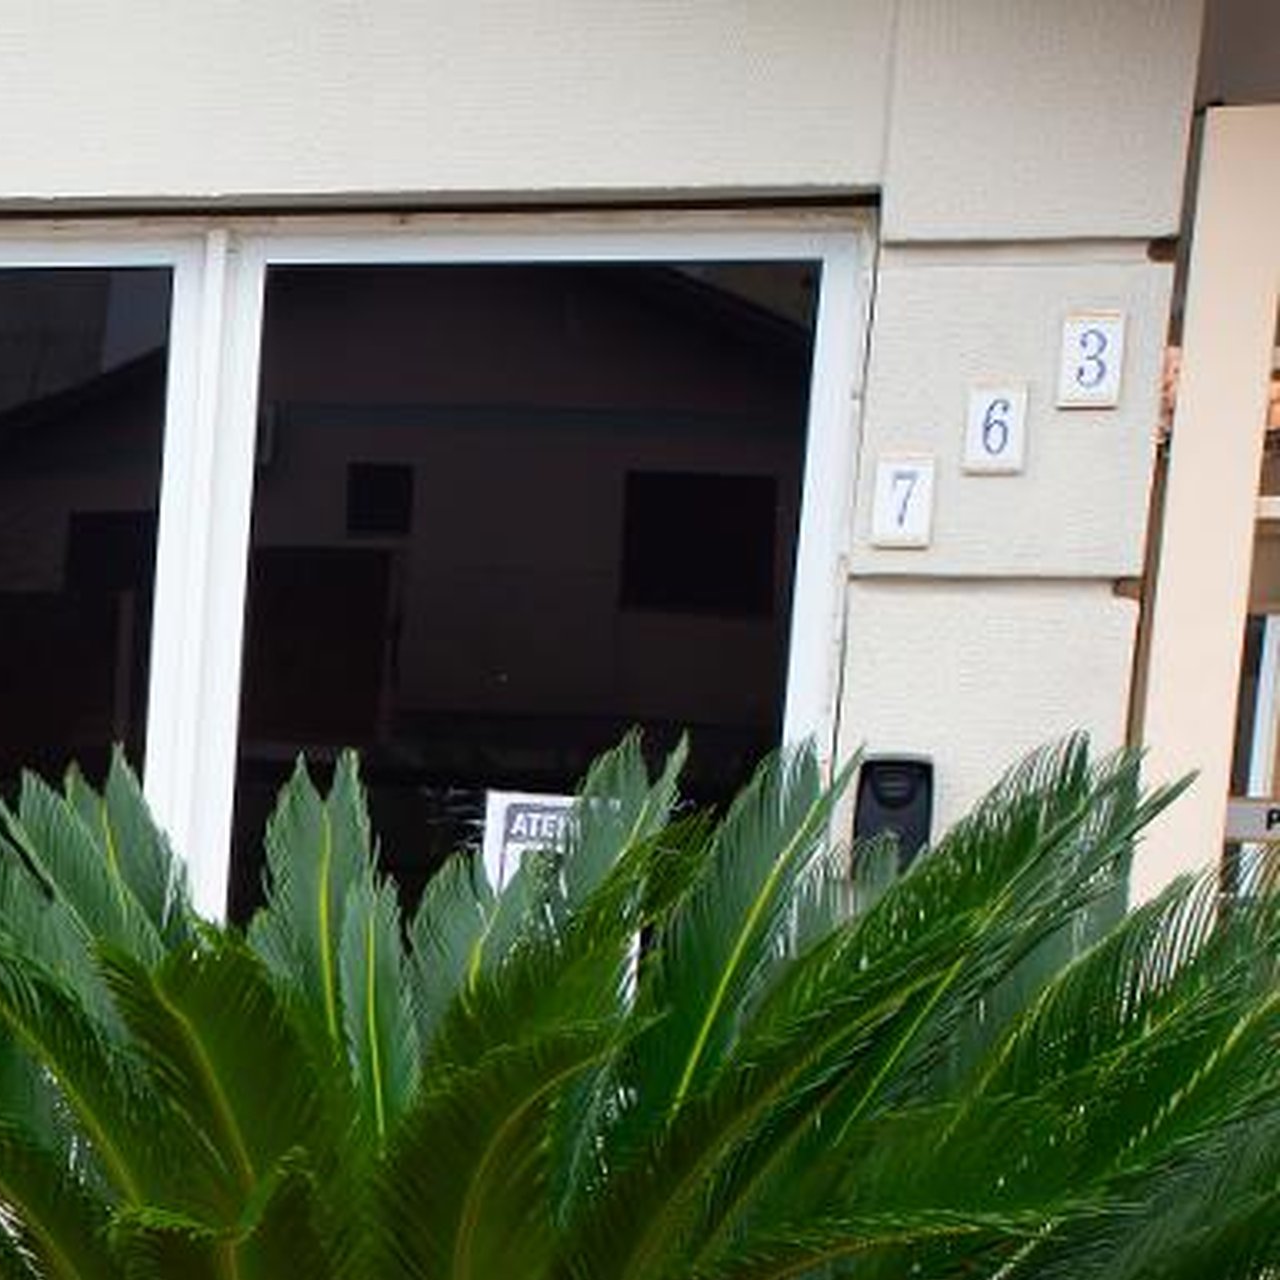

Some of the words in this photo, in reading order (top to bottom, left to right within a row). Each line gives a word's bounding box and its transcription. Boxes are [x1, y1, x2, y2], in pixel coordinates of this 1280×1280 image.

[893, 471, 918, 527] 7
[982, 398, 1010, 455] 6
[1076, 329, 1107, 388] 3
